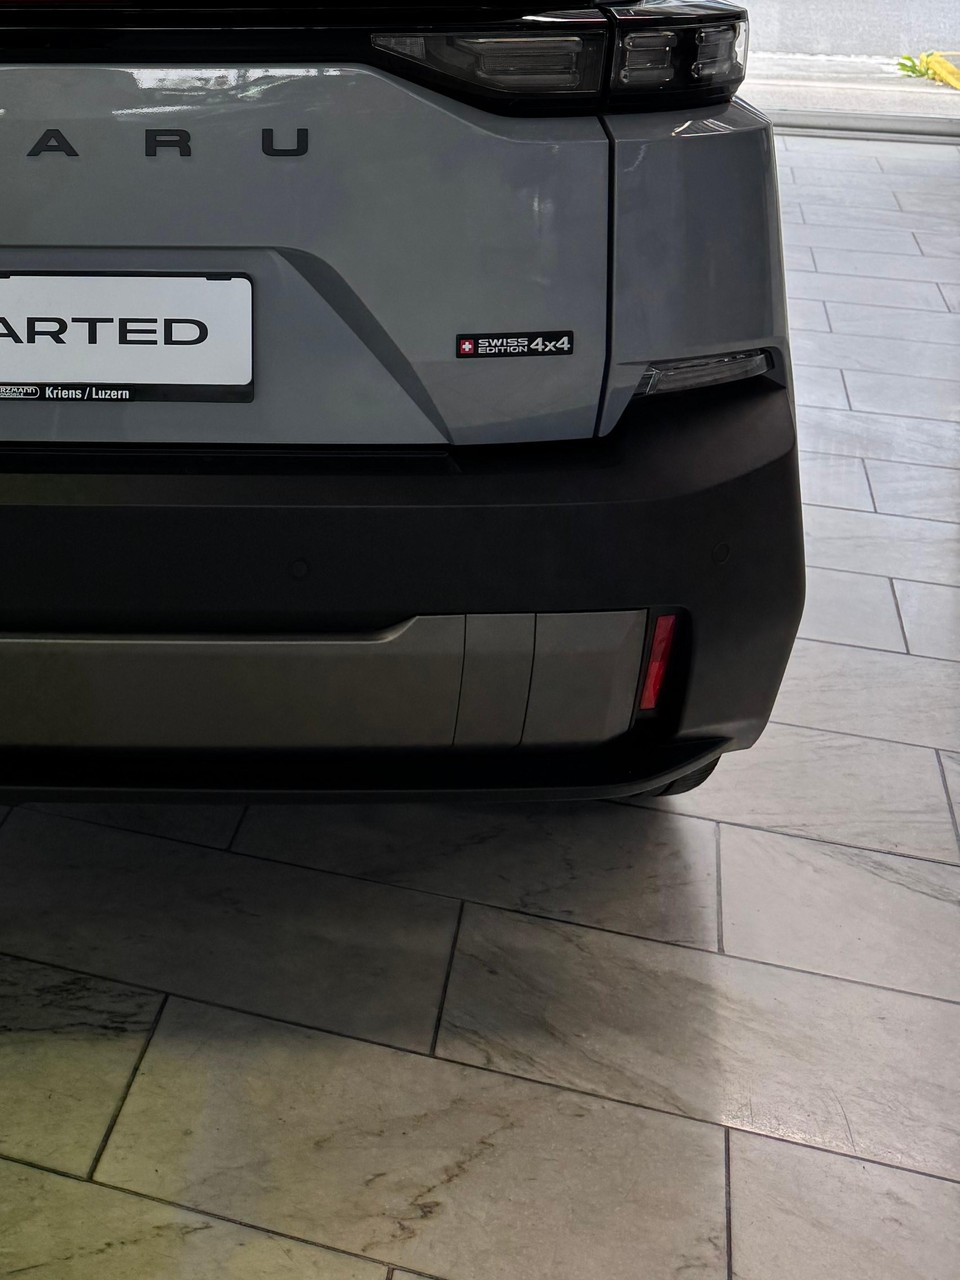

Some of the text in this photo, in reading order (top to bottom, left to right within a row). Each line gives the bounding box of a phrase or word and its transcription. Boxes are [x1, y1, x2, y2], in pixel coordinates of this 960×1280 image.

[478, 338, 529, 347] SWISS
[530, 336, 571, 352] 4x4
[478, 346, 528, 354] EDITION
[45, 387, 82, 399] Kriens
[92, 387, 130, 400] Luzern
